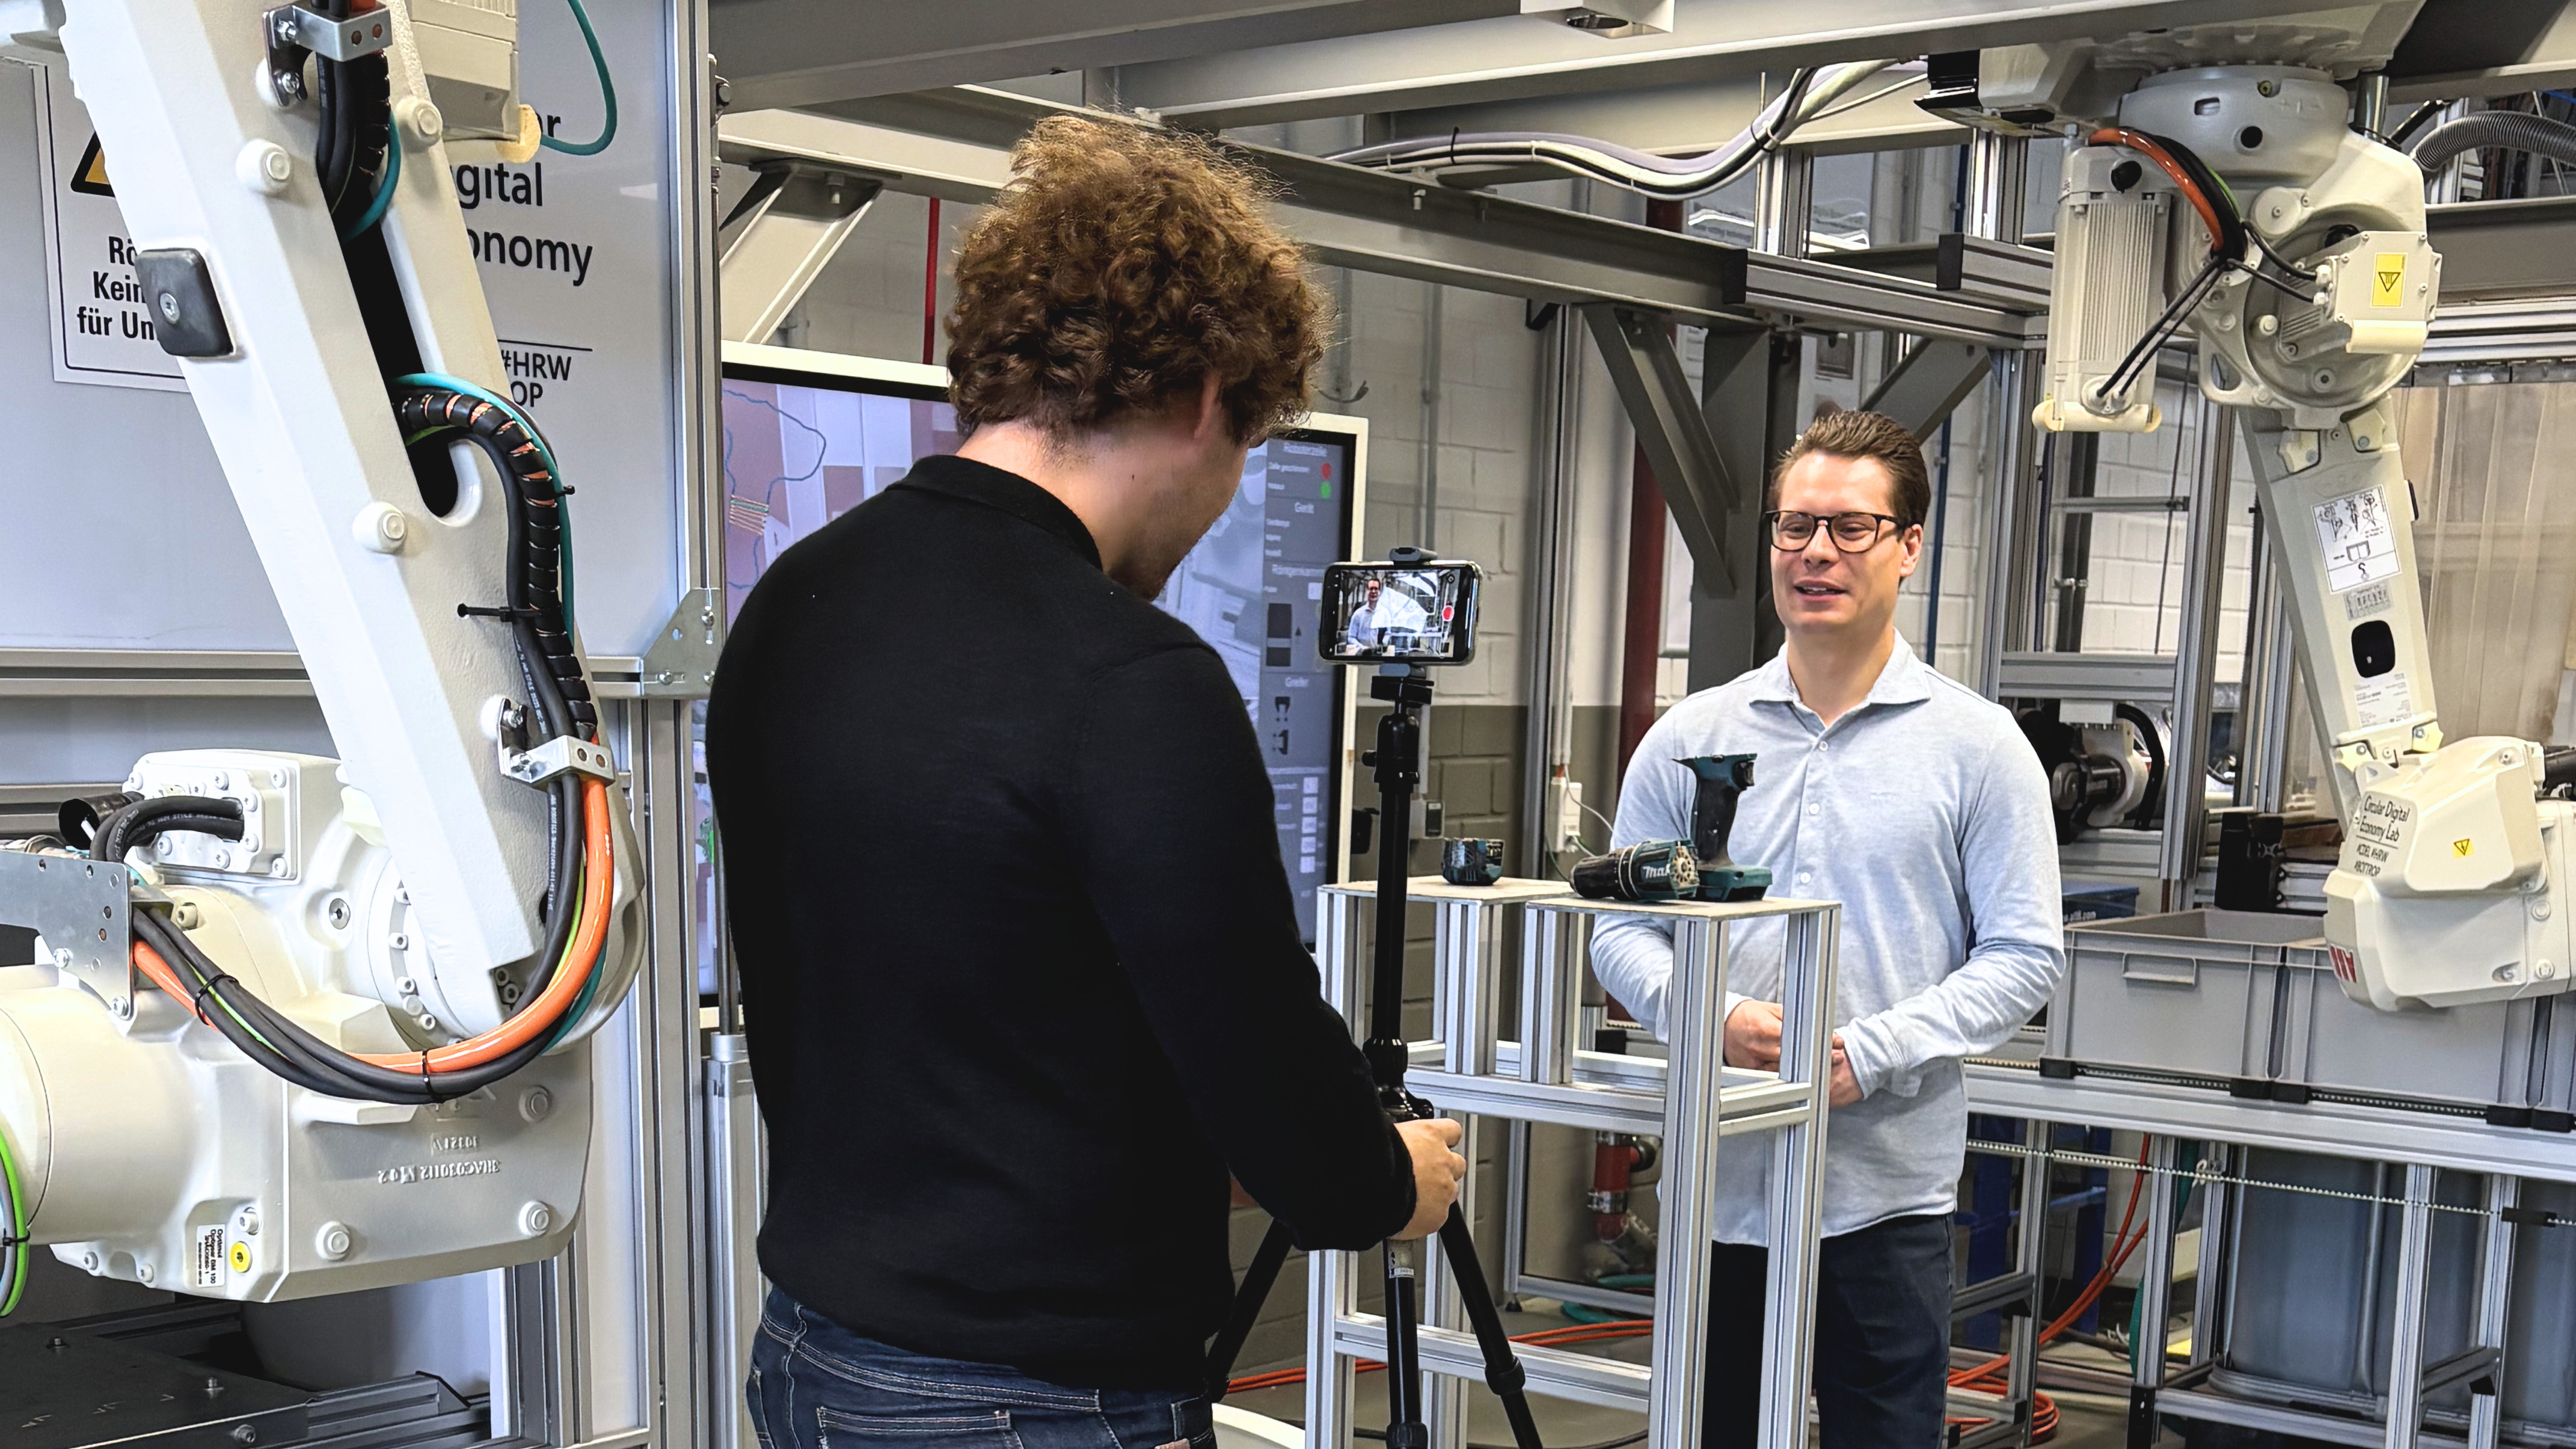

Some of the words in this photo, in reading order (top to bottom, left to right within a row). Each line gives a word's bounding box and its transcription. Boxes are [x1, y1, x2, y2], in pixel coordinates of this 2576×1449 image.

[450, 162, 543, 209] gital
[77, 306, 112, 336] für
[121, 310, 155, 340] Un
[501, 349, 572, 381] #HRW
[2385, 801, 2411, 823] Digital
[2385, 823, 2400, 842] Lab
